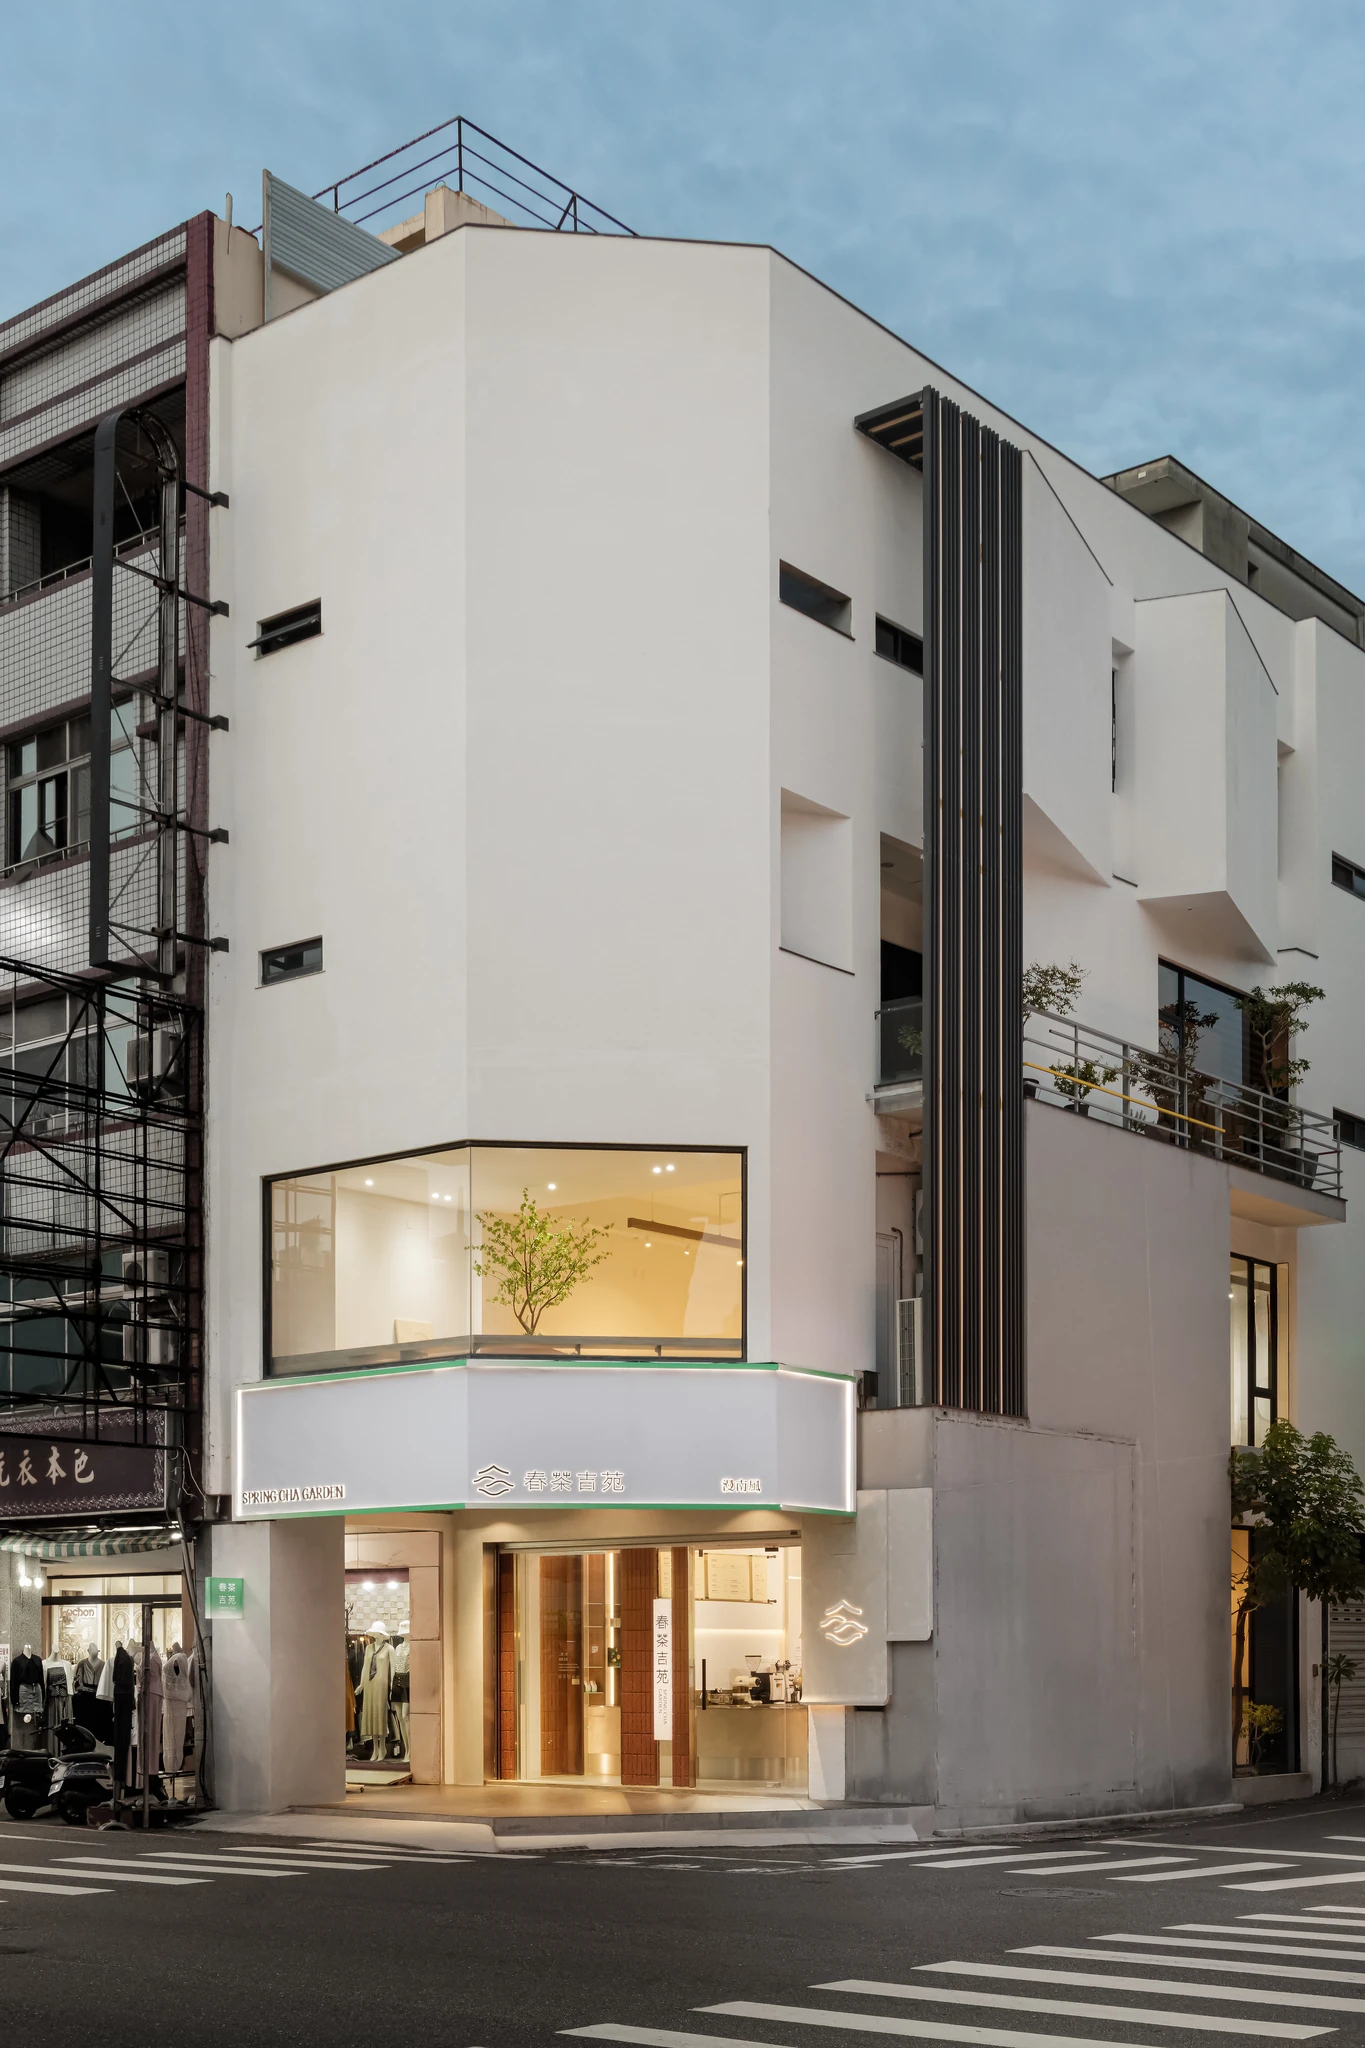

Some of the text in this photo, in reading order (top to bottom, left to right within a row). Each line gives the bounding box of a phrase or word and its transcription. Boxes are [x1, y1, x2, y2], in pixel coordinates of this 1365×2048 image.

[523, 1471, 624, 1492] 春茶吉苑
[242, 1485, 344, 1504] SPRING CHA GARDEN
[218, 1582, 236, 1592] 春茶
[218, 1595, 236, 1605] 吉苑
[656, 1615, 669, 1684] 春茶吉苑
